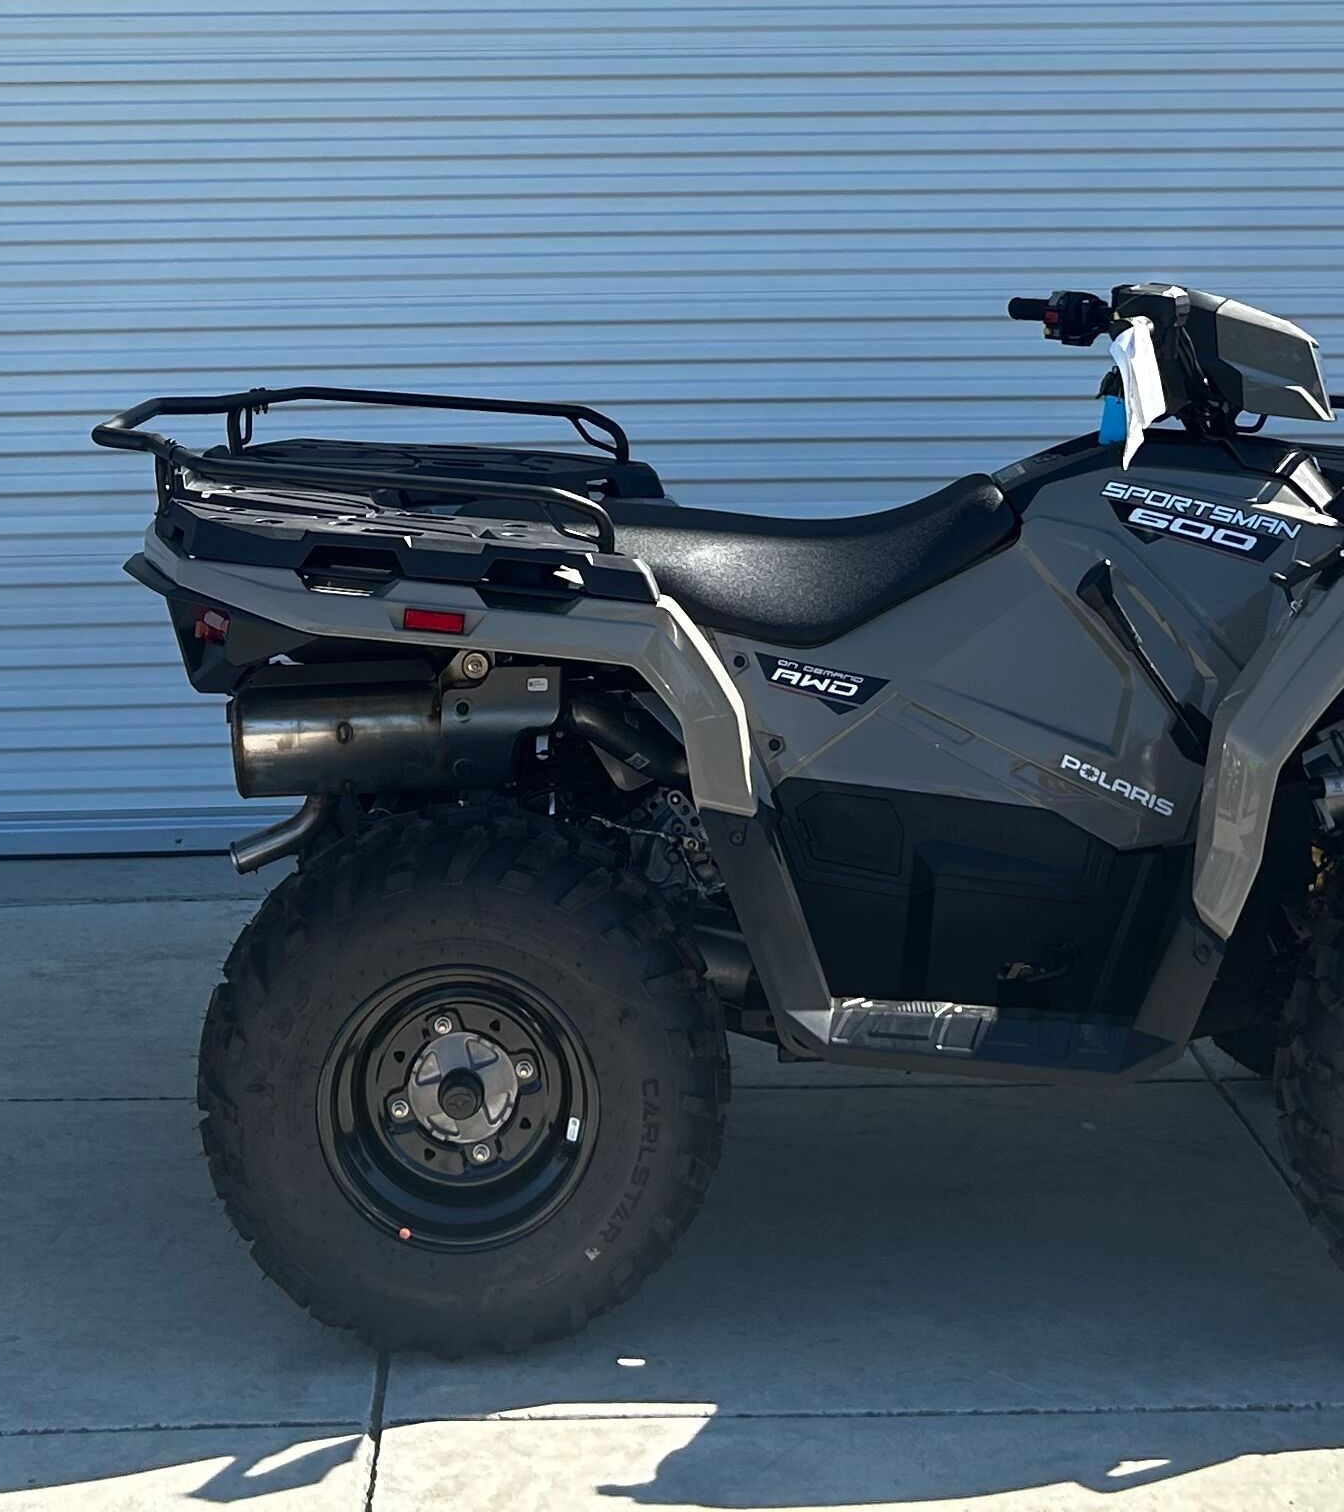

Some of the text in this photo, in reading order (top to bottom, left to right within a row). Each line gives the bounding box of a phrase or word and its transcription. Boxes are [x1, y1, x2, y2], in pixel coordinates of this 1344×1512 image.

[1100, 481, 1302, 539] SPORTSMAN
[1127, 507, 1258, 552] 600
[771, 667, 859, 697] AWD
[1060, 754, 1174, 817] POLARIS
[598, 1077, 661, 1245] CARLSTAR
